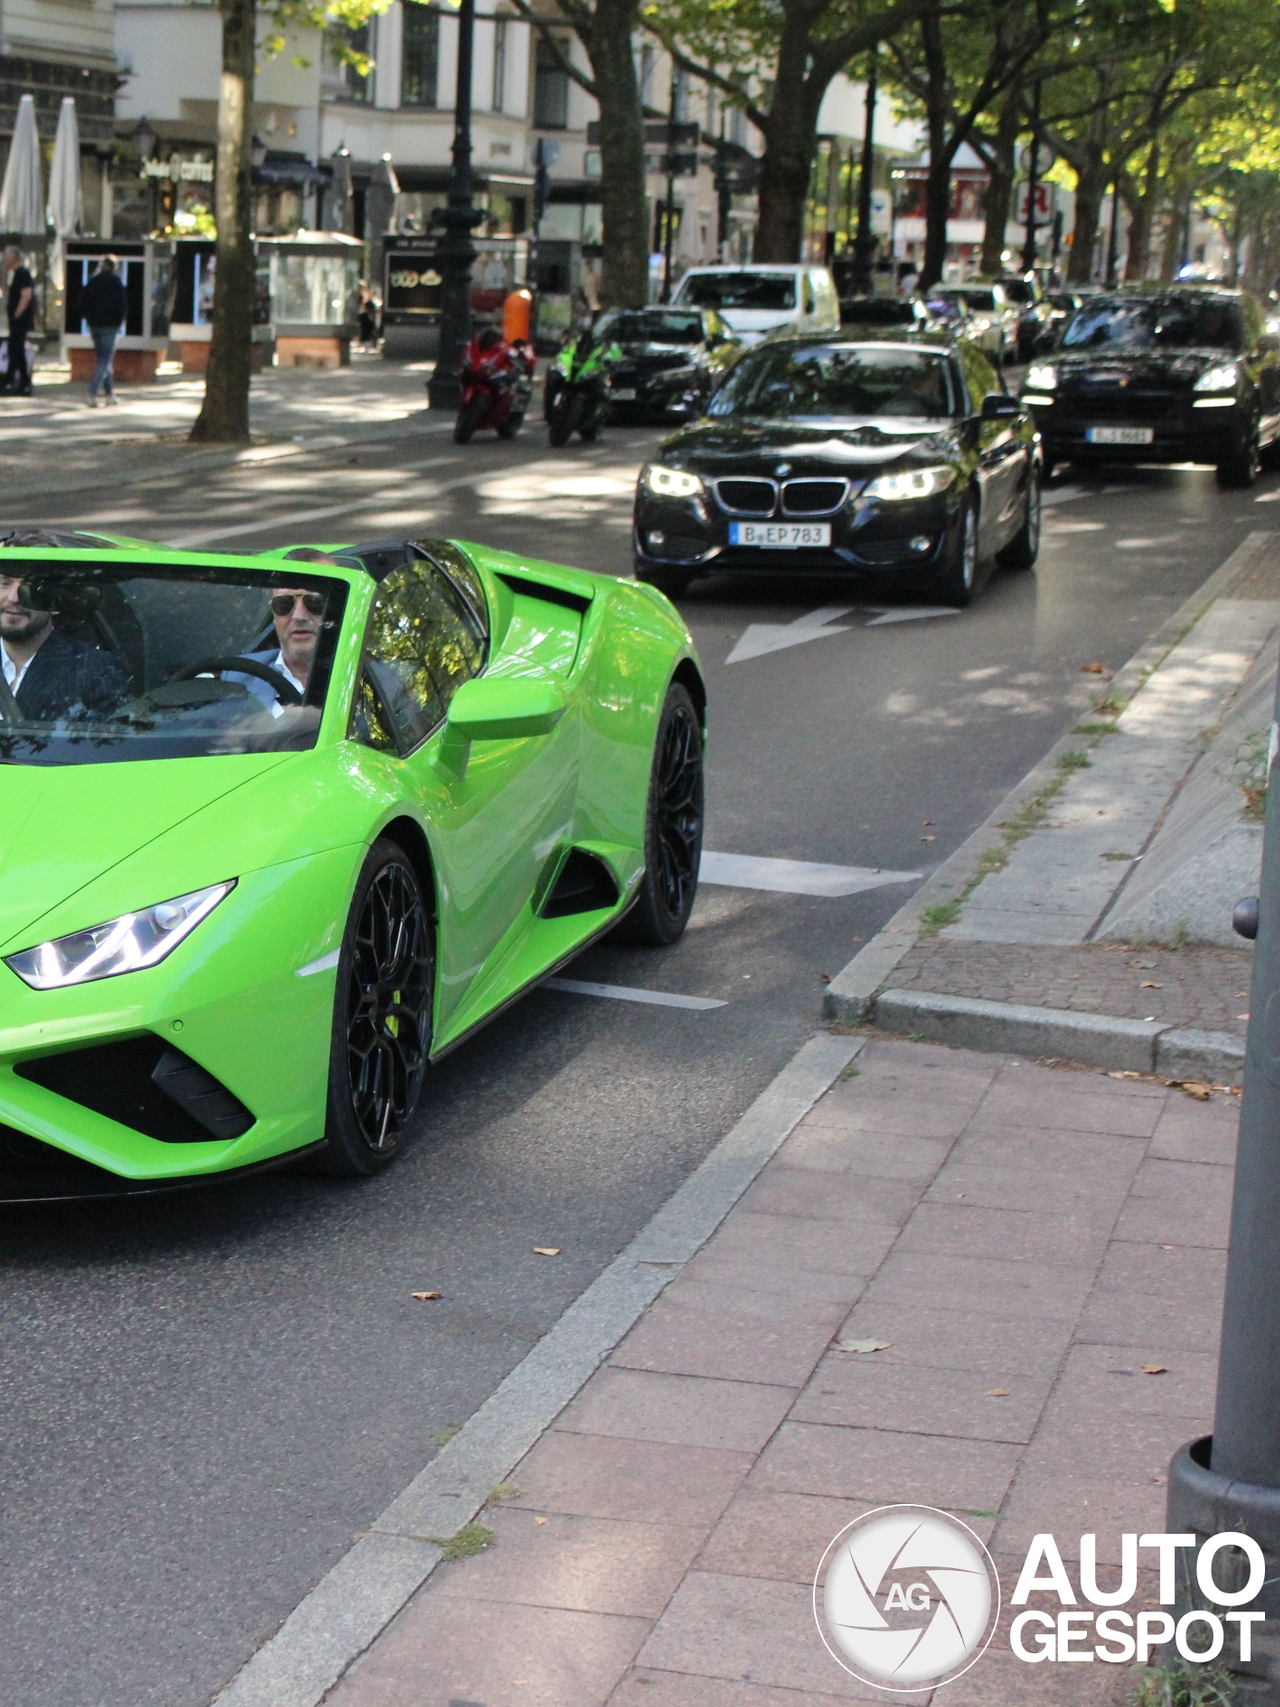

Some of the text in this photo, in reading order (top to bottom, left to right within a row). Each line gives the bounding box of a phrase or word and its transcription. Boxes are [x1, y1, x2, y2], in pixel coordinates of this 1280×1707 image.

[745, 527, 823, 543] B EP 783
